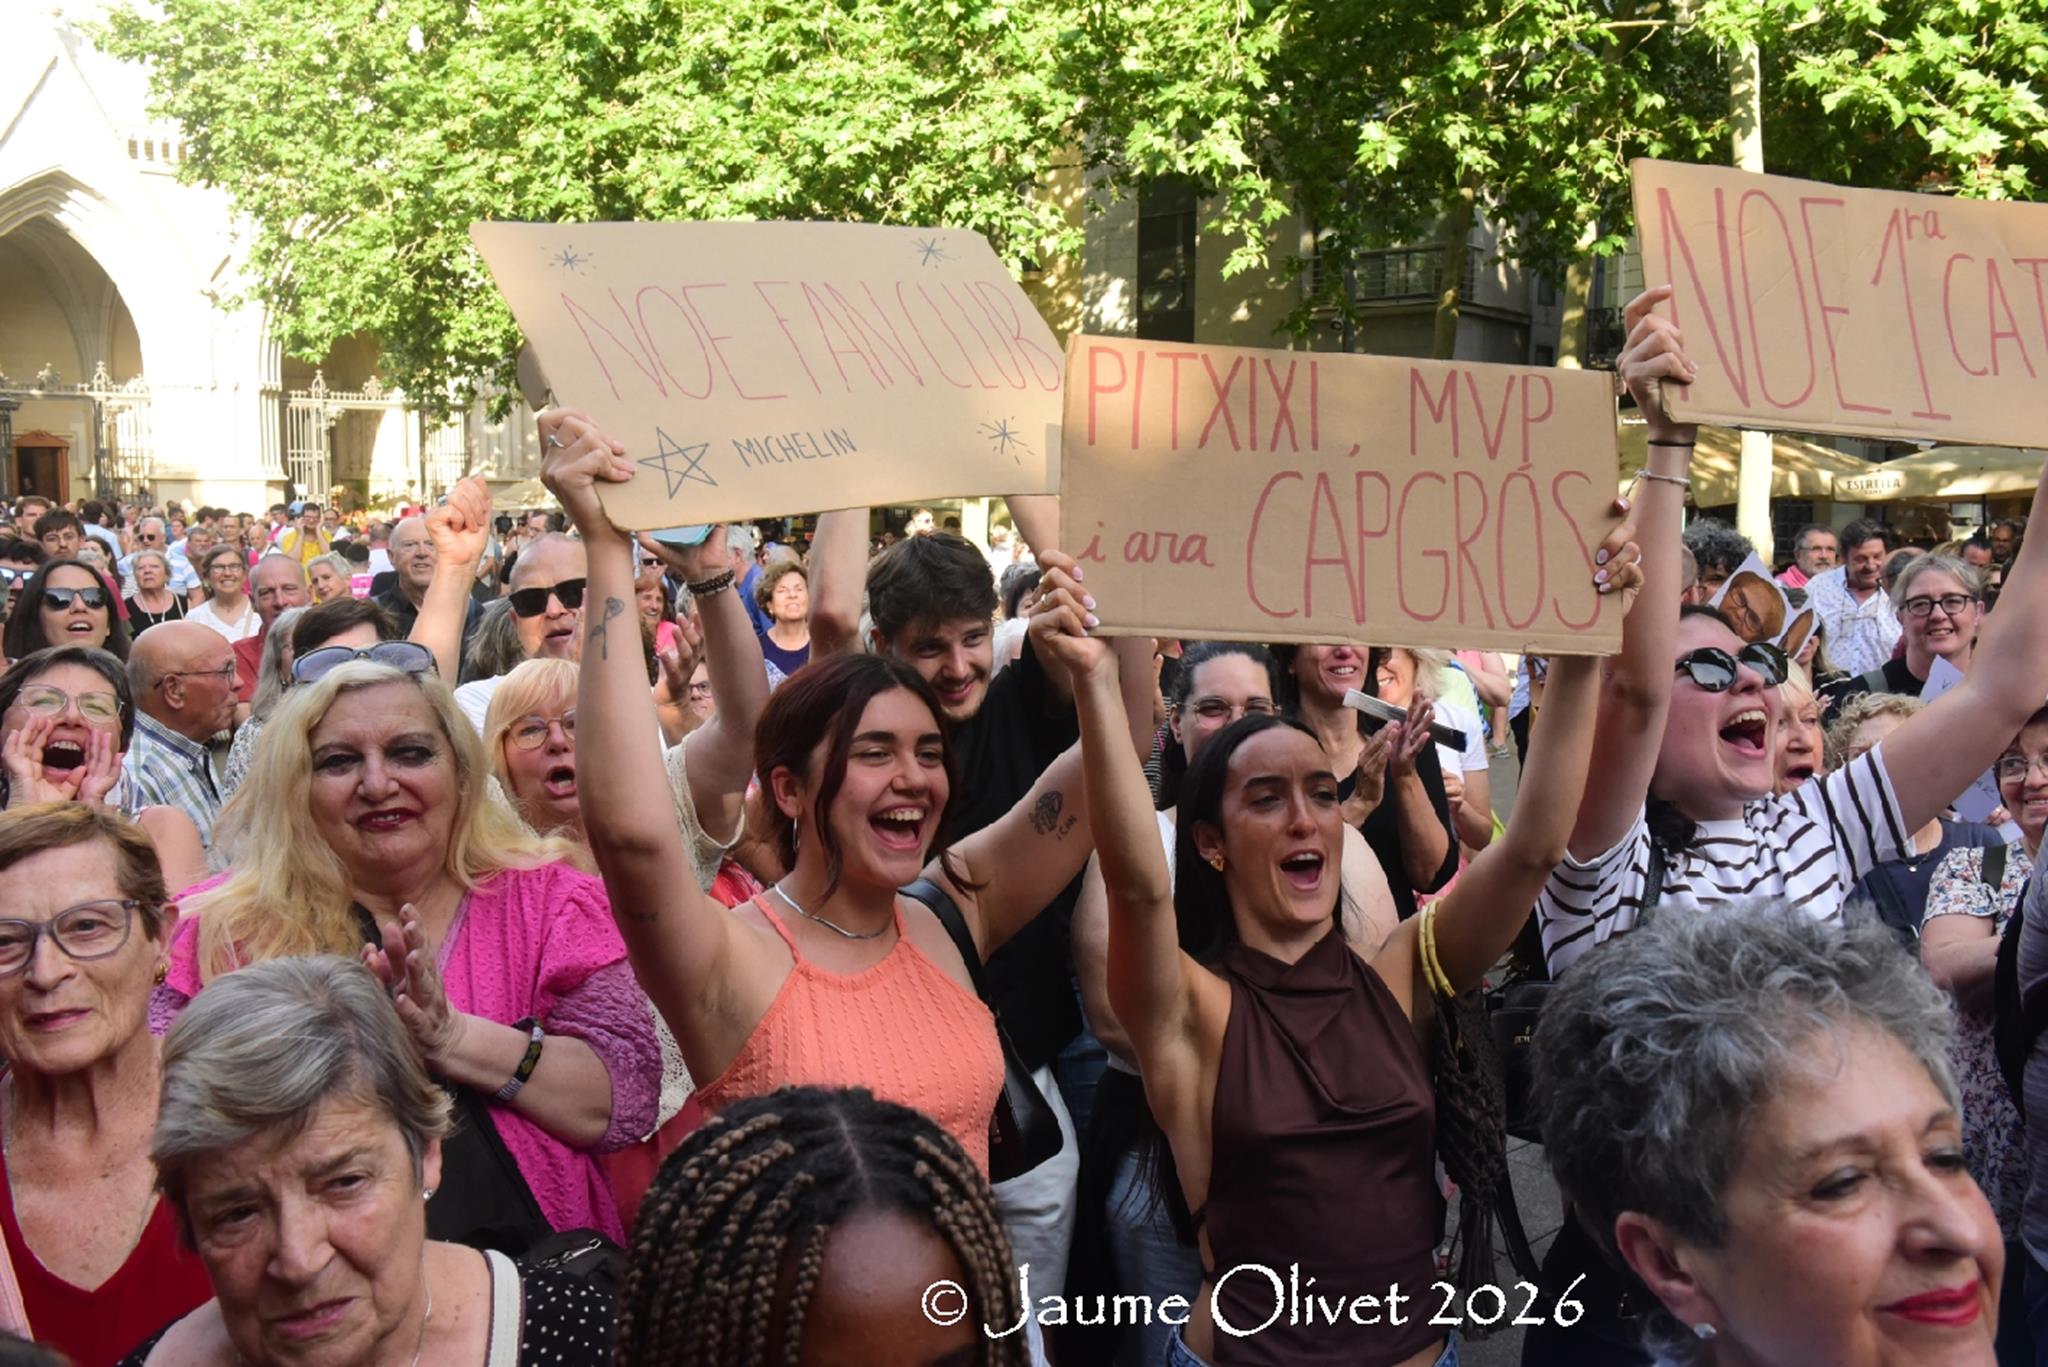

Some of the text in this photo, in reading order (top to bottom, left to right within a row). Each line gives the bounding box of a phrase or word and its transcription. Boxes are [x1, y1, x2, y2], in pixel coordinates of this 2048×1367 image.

[559, 282, 788, 400] NOE
[1656, 188, 1892, 415] NOE
[732, 428, 857, 467] MICHELIN
[1087, 345, 1554, 462] PITXIXI, MVP
[1077, 463, 1602, 631] i ara CAPGRÓS
